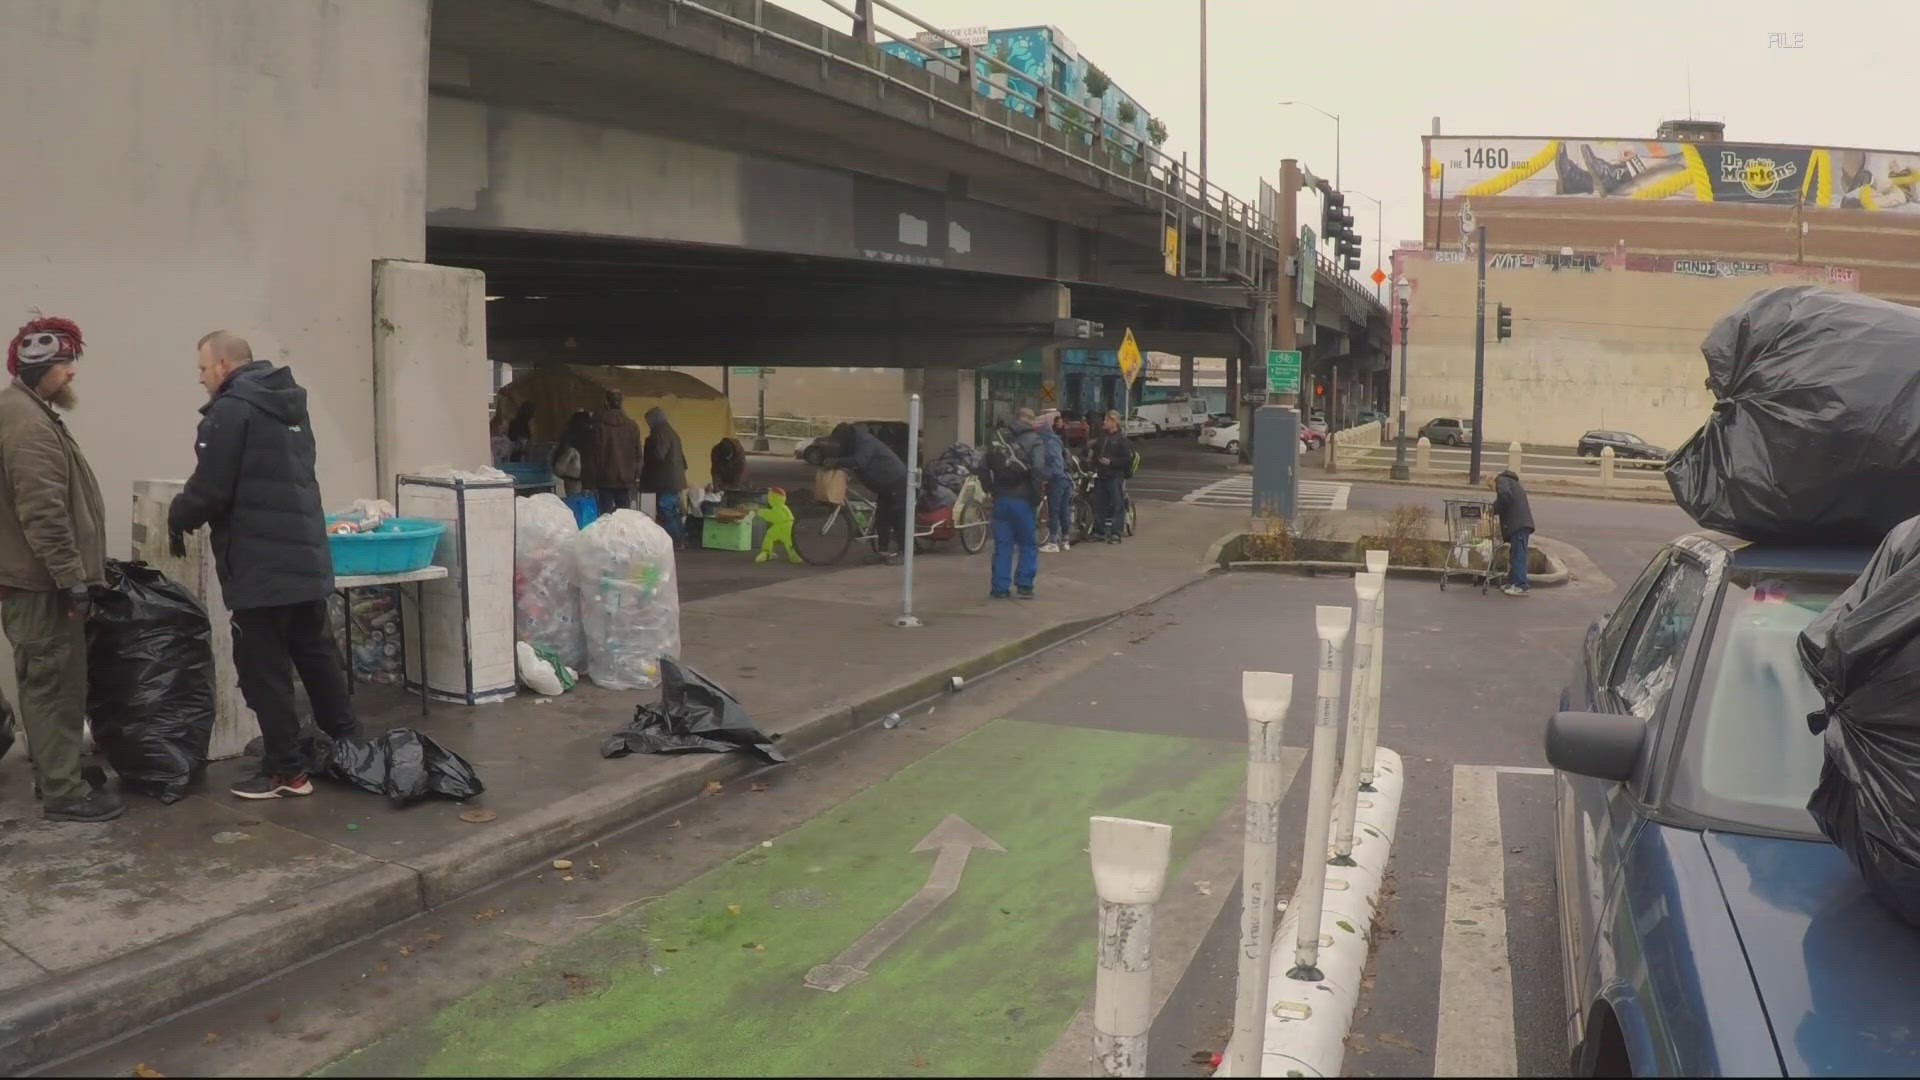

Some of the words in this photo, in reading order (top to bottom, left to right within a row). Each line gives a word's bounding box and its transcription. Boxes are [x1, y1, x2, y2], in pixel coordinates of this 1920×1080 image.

[963, 26, 987, 35] LEASE
[1450, 160, 1463, 169] THE
[1464, 147, 1508, 169] 1460
[1511, 160, 1530, 170] BOOT
[1721, 162, 1797, 182] Martens
